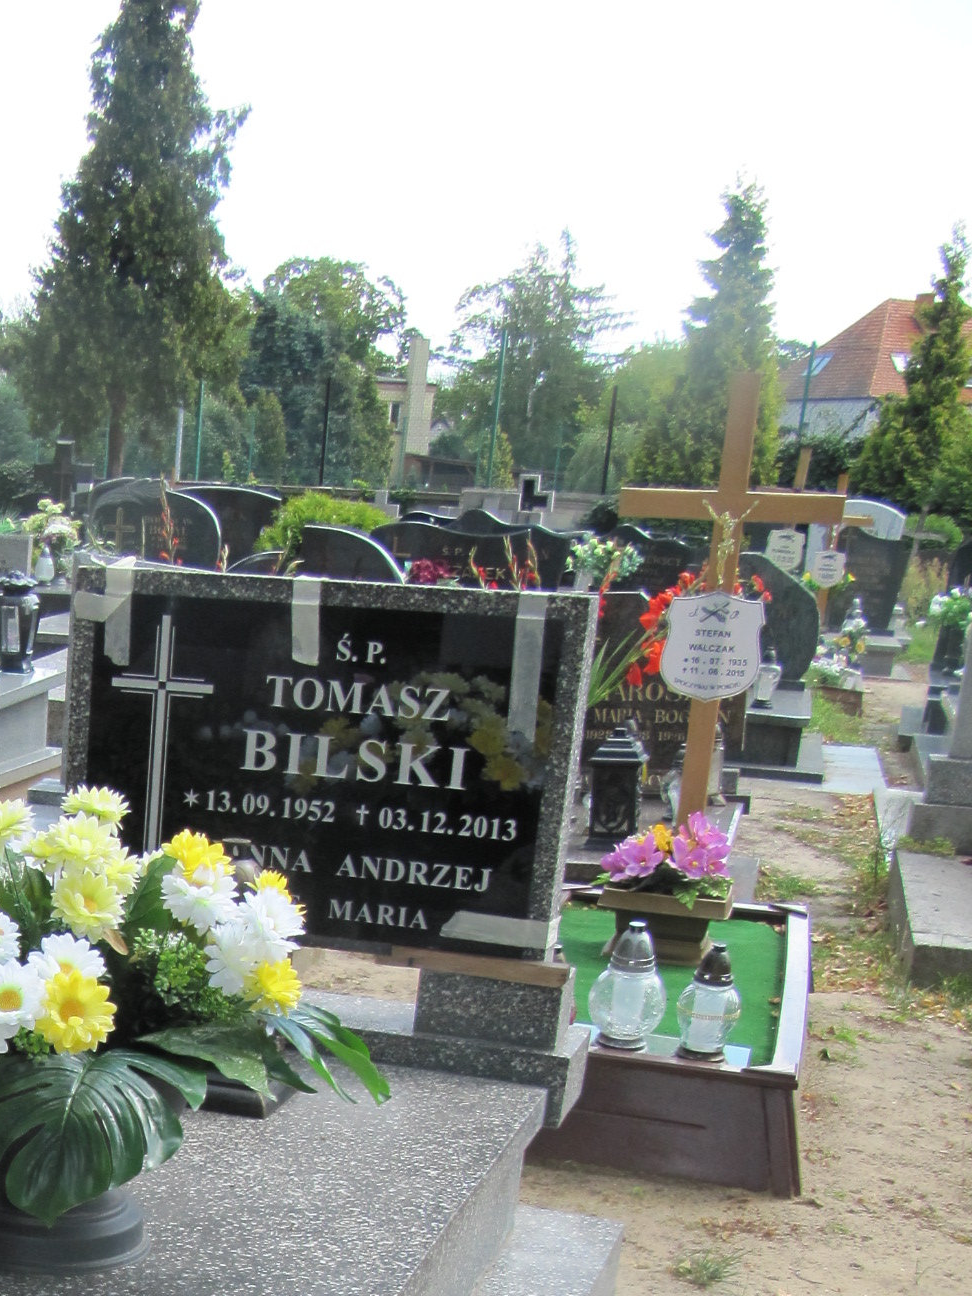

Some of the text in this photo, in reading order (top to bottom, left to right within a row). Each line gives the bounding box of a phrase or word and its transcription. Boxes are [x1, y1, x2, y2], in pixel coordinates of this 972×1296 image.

[336, 633, 387, 664] Ś. P.
[688, 643, 736, 654] WALCZAK
[695, 628, 732, 639] STEFAN
[266, 674, 450, 721] TOMASZ
[239, 728, 470, 791] BILSKI
[335, 853, 494, 893] ANDRZEJ
[328, 898, 429, 930] MARIA
